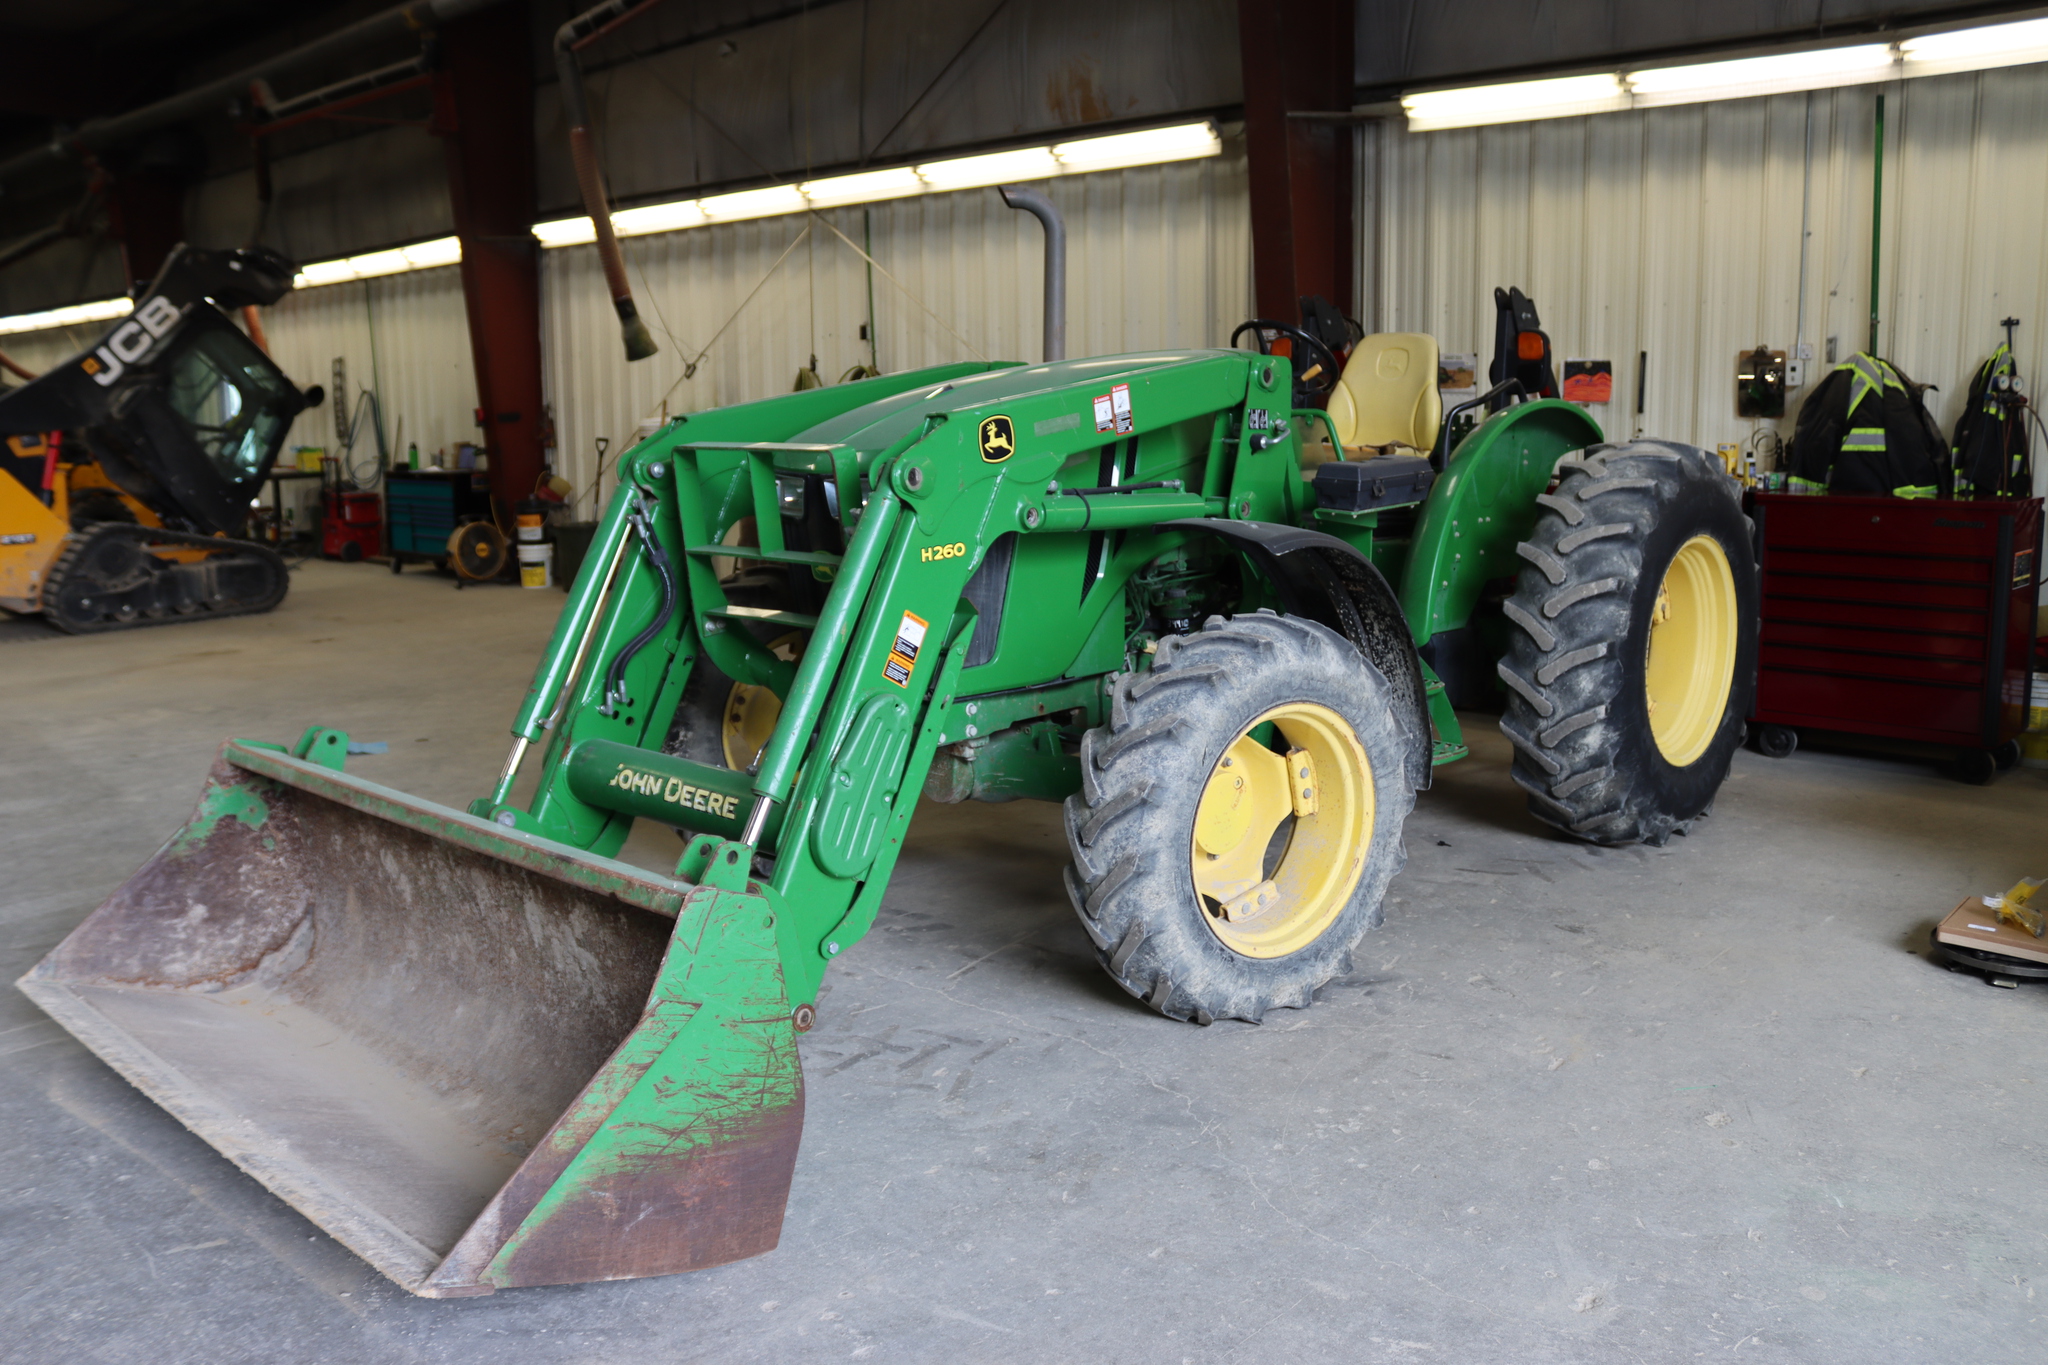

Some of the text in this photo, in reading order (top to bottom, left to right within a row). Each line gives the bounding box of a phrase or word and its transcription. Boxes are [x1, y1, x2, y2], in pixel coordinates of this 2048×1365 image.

[93, 295, 181, 387] JCB
[921, 541, 966, 563] H260
[608, 763, 739, 820] JOHN DEERE
